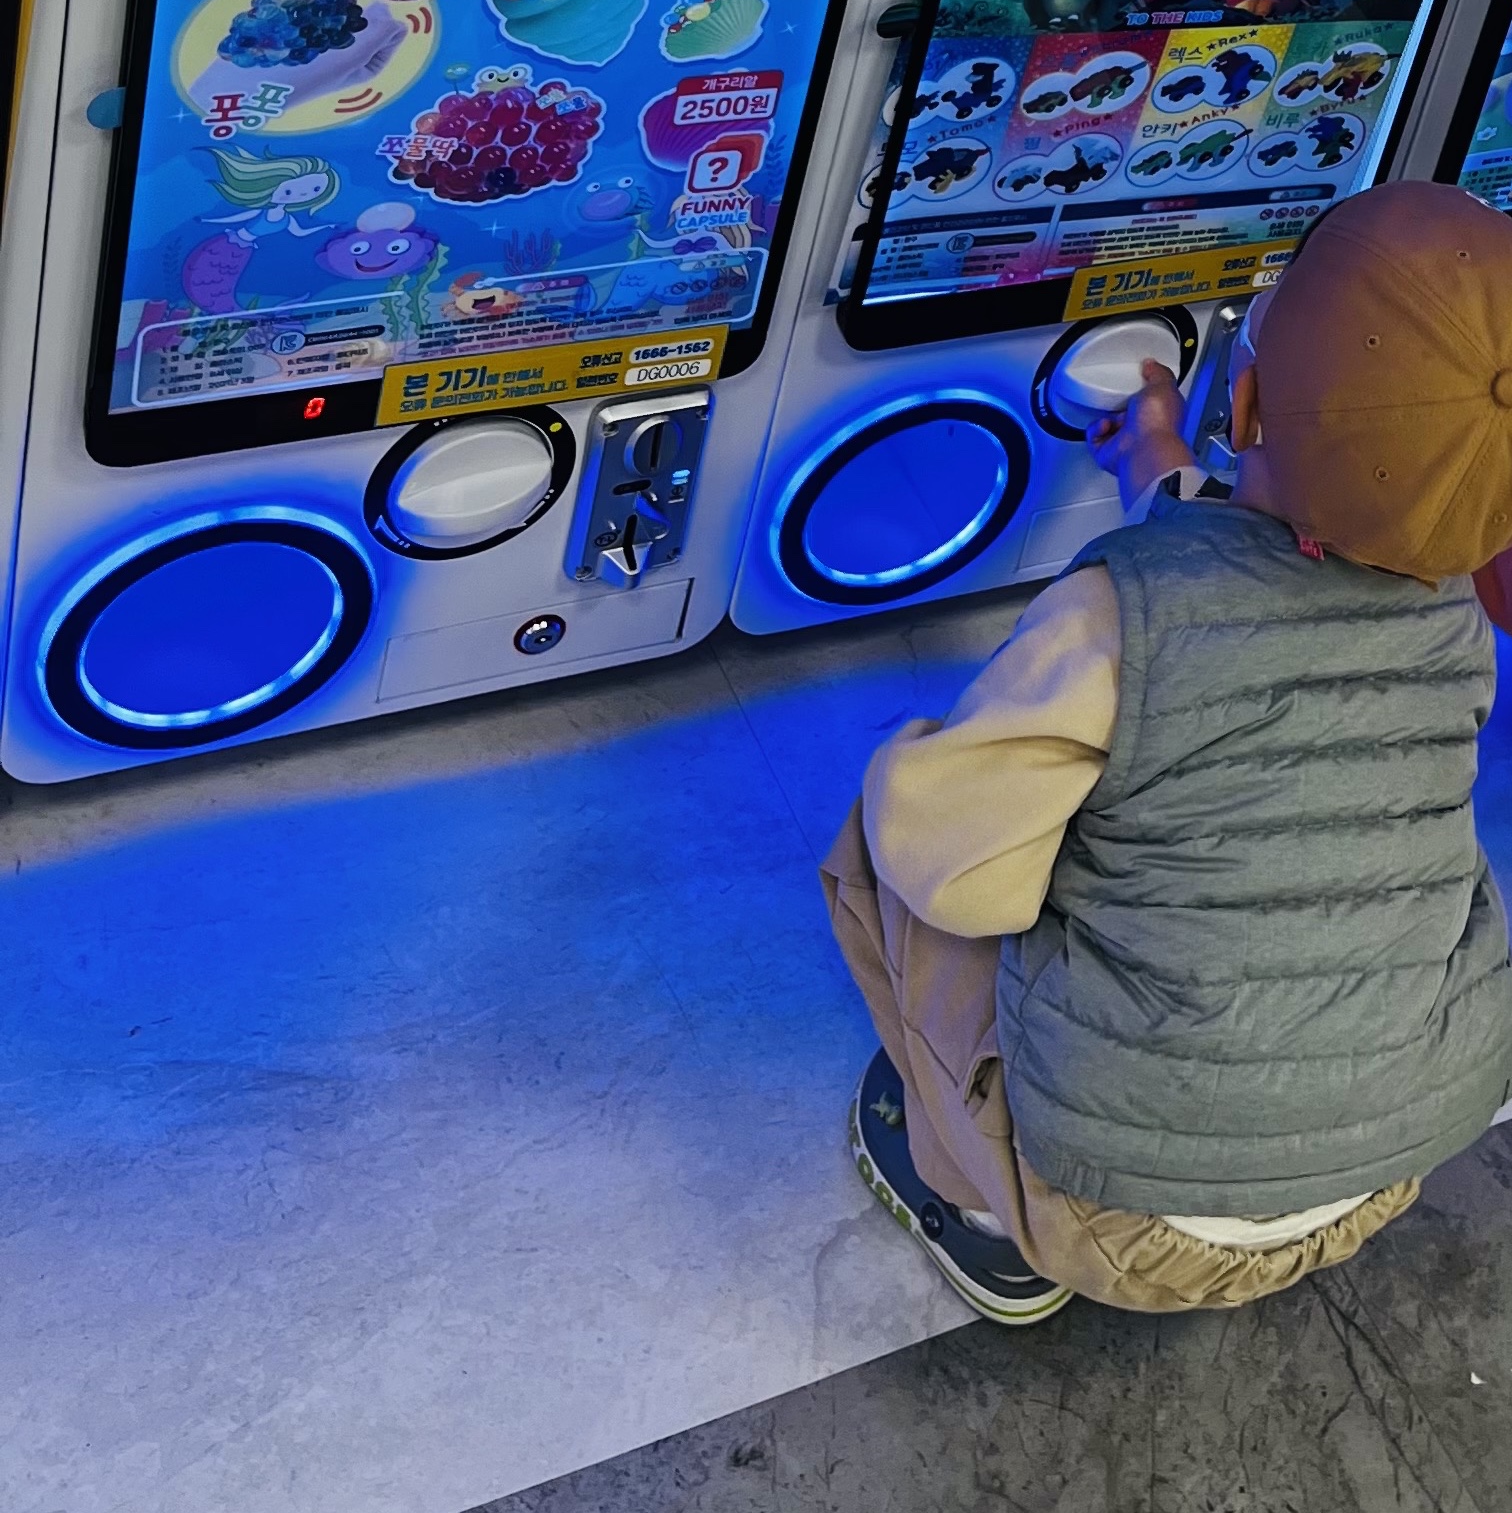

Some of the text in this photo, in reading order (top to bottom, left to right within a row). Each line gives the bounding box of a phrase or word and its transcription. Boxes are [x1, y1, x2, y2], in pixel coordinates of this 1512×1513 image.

[1126, 10, 1223, 26] TO THE KIDS
[1167, 45, 1204, 64] 렉스
[1219, 32, 1247, 48] Rex
[703, 74, 759, 91] 개구리알
[681, 94, 771, 121] 2500원
[680, 196, 750, 216] FUNNY
[675, 210, 748, 230] CAPSULE
[633, 340, 711, 362] 1666-1562
[636, 361, 701, 383] DG0006
[402, 372, 430, 398] 본
